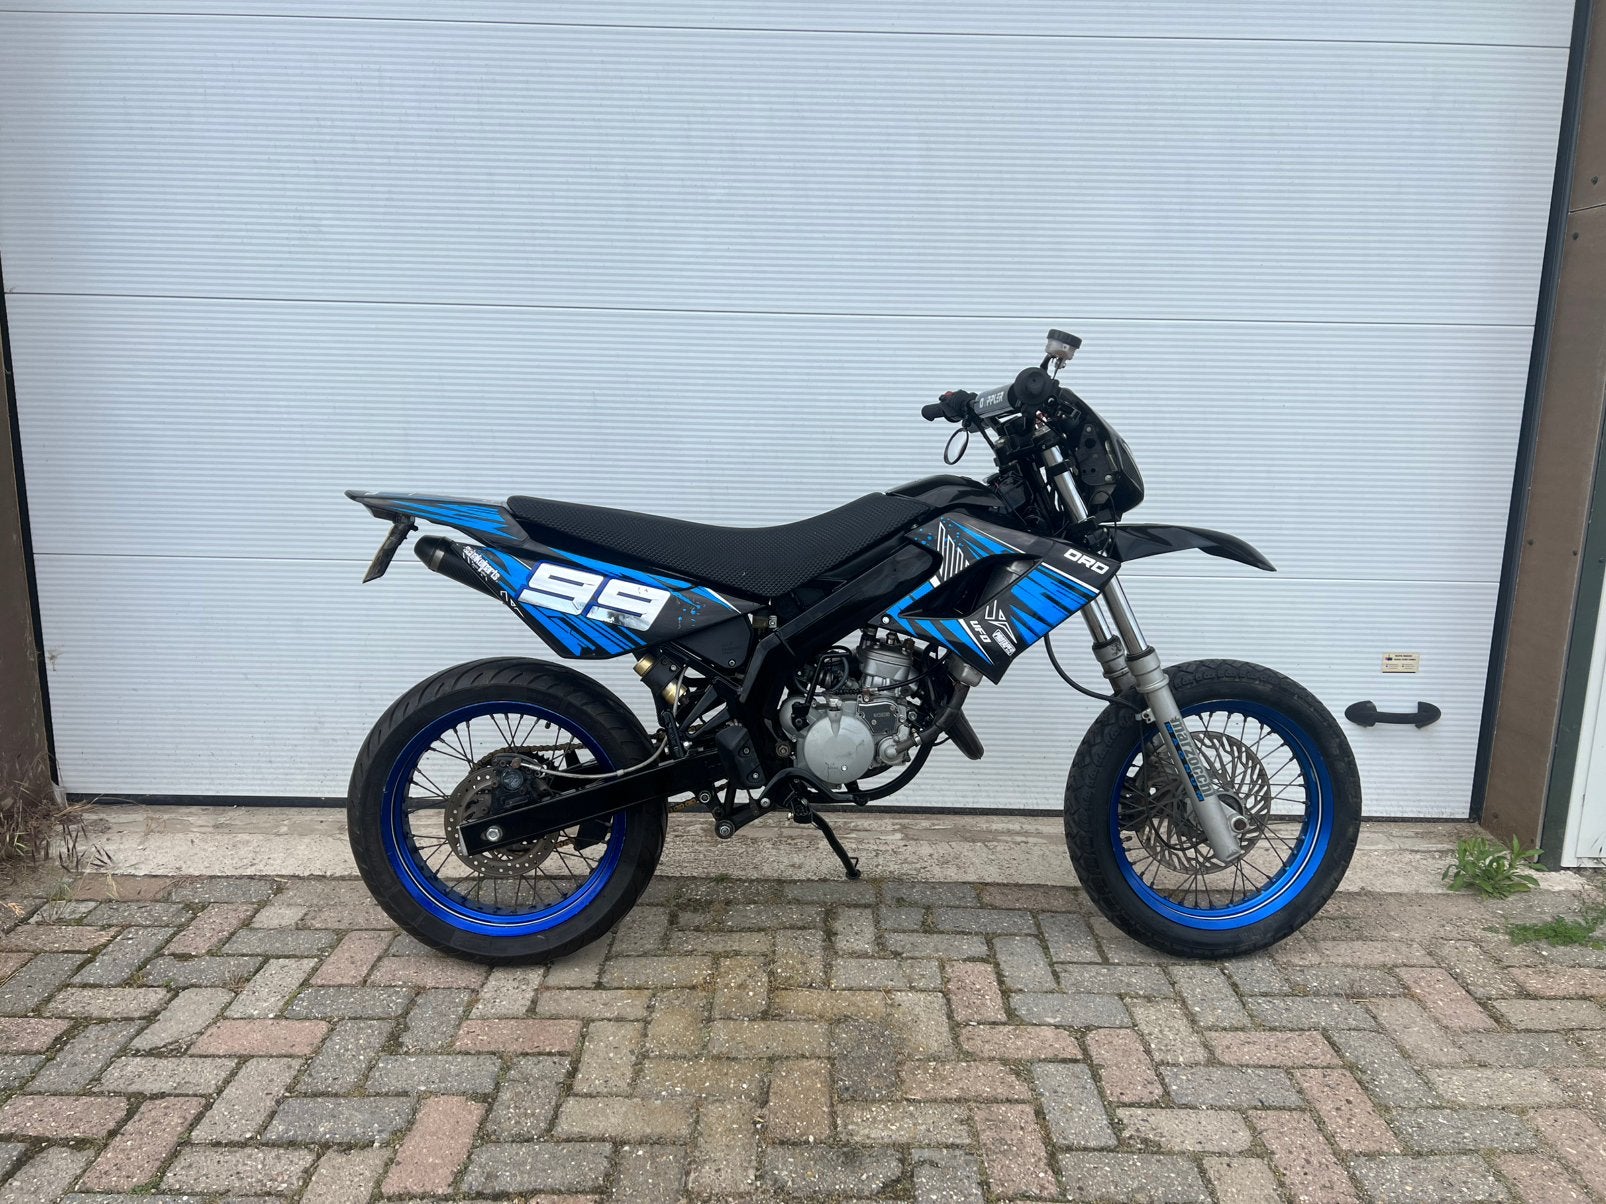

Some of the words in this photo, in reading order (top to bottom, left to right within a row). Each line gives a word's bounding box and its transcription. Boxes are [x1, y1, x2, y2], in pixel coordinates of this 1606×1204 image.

[516, 561, 671, 632] 99
[969, 620, 992, 643] UFO
[1164, 722, 1205, 801] MAGNUM
